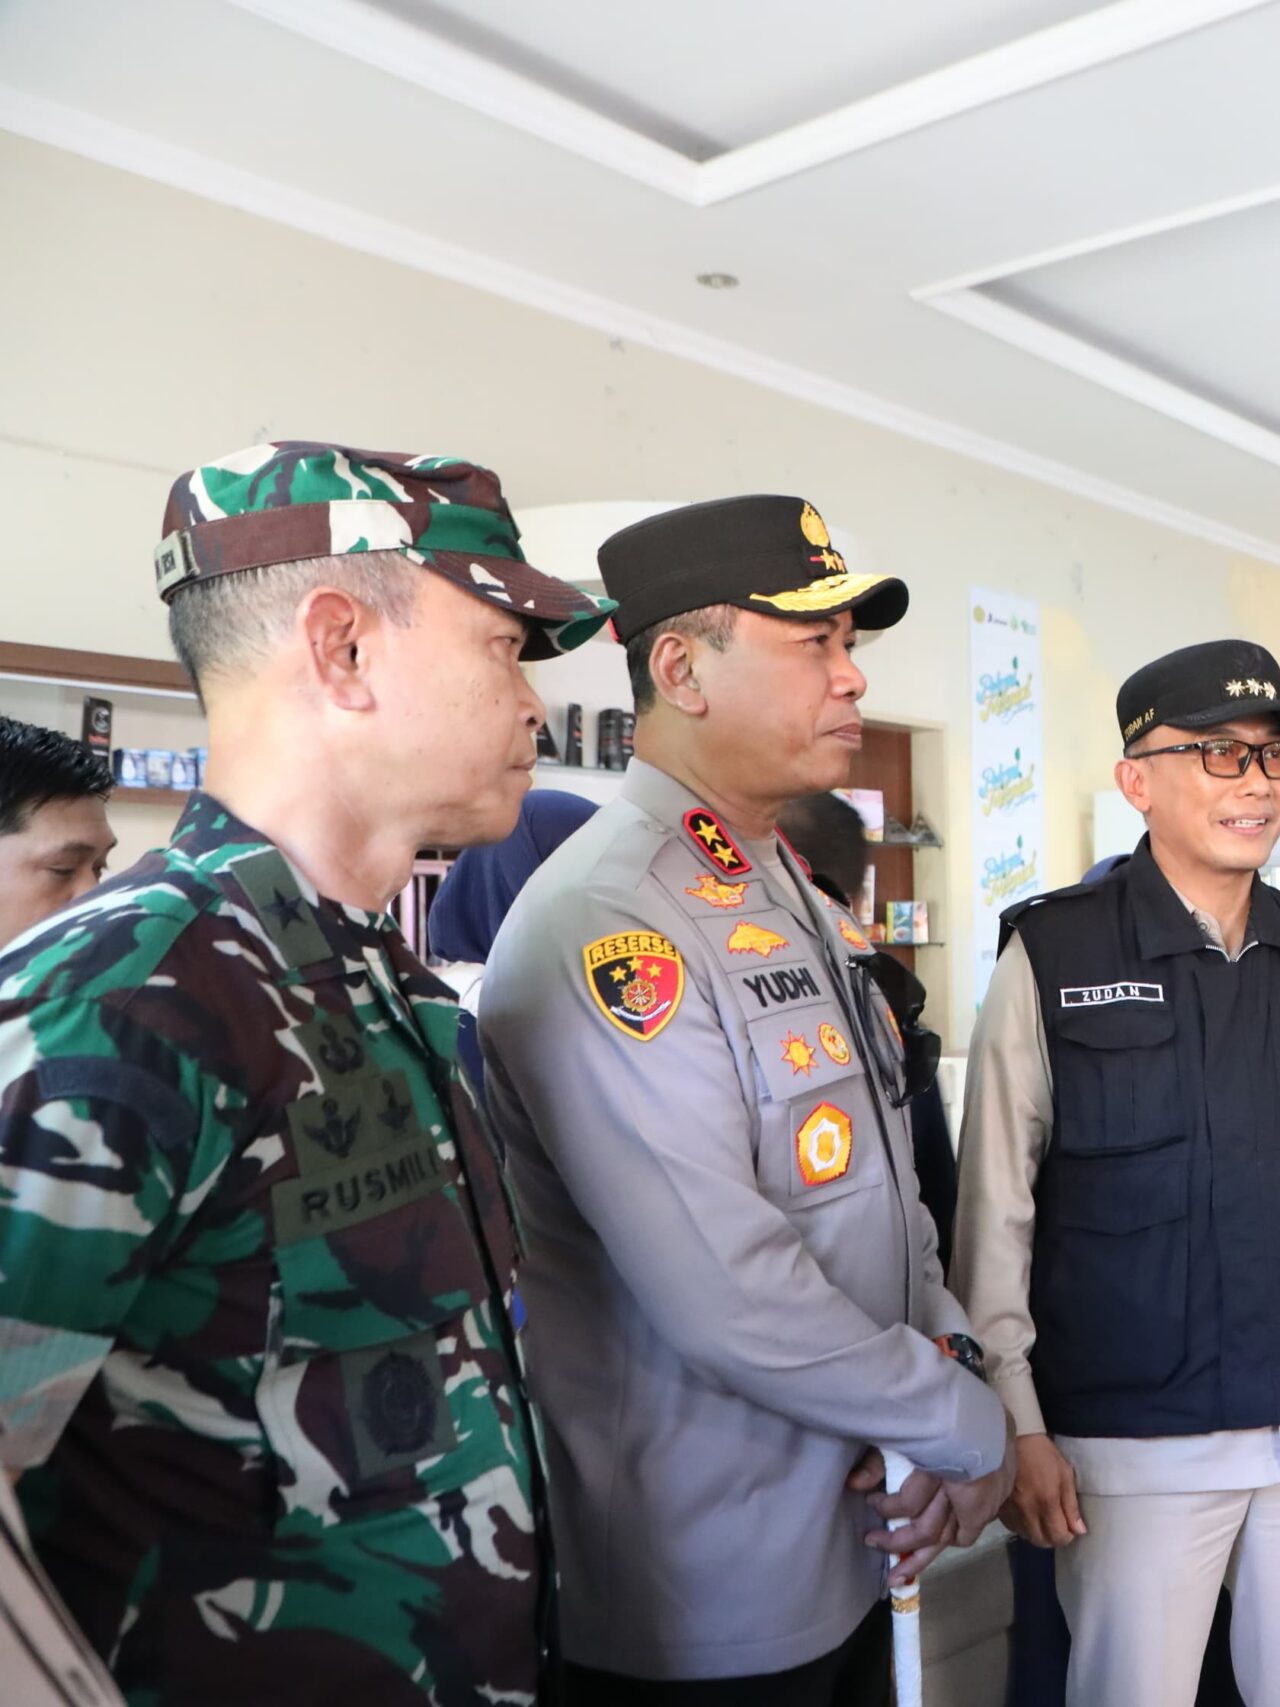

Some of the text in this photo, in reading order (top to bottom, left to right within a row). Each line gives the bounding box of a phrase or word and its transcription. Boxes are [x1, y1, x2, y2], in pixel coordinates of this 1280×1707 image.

[1144, 707, 1155, 724] AF
[591, 935, 676, 963] RESERSE
[742, 966, 821, 1008] YUDHI
[1081, 985, 1140, 1002] ZUDAN
